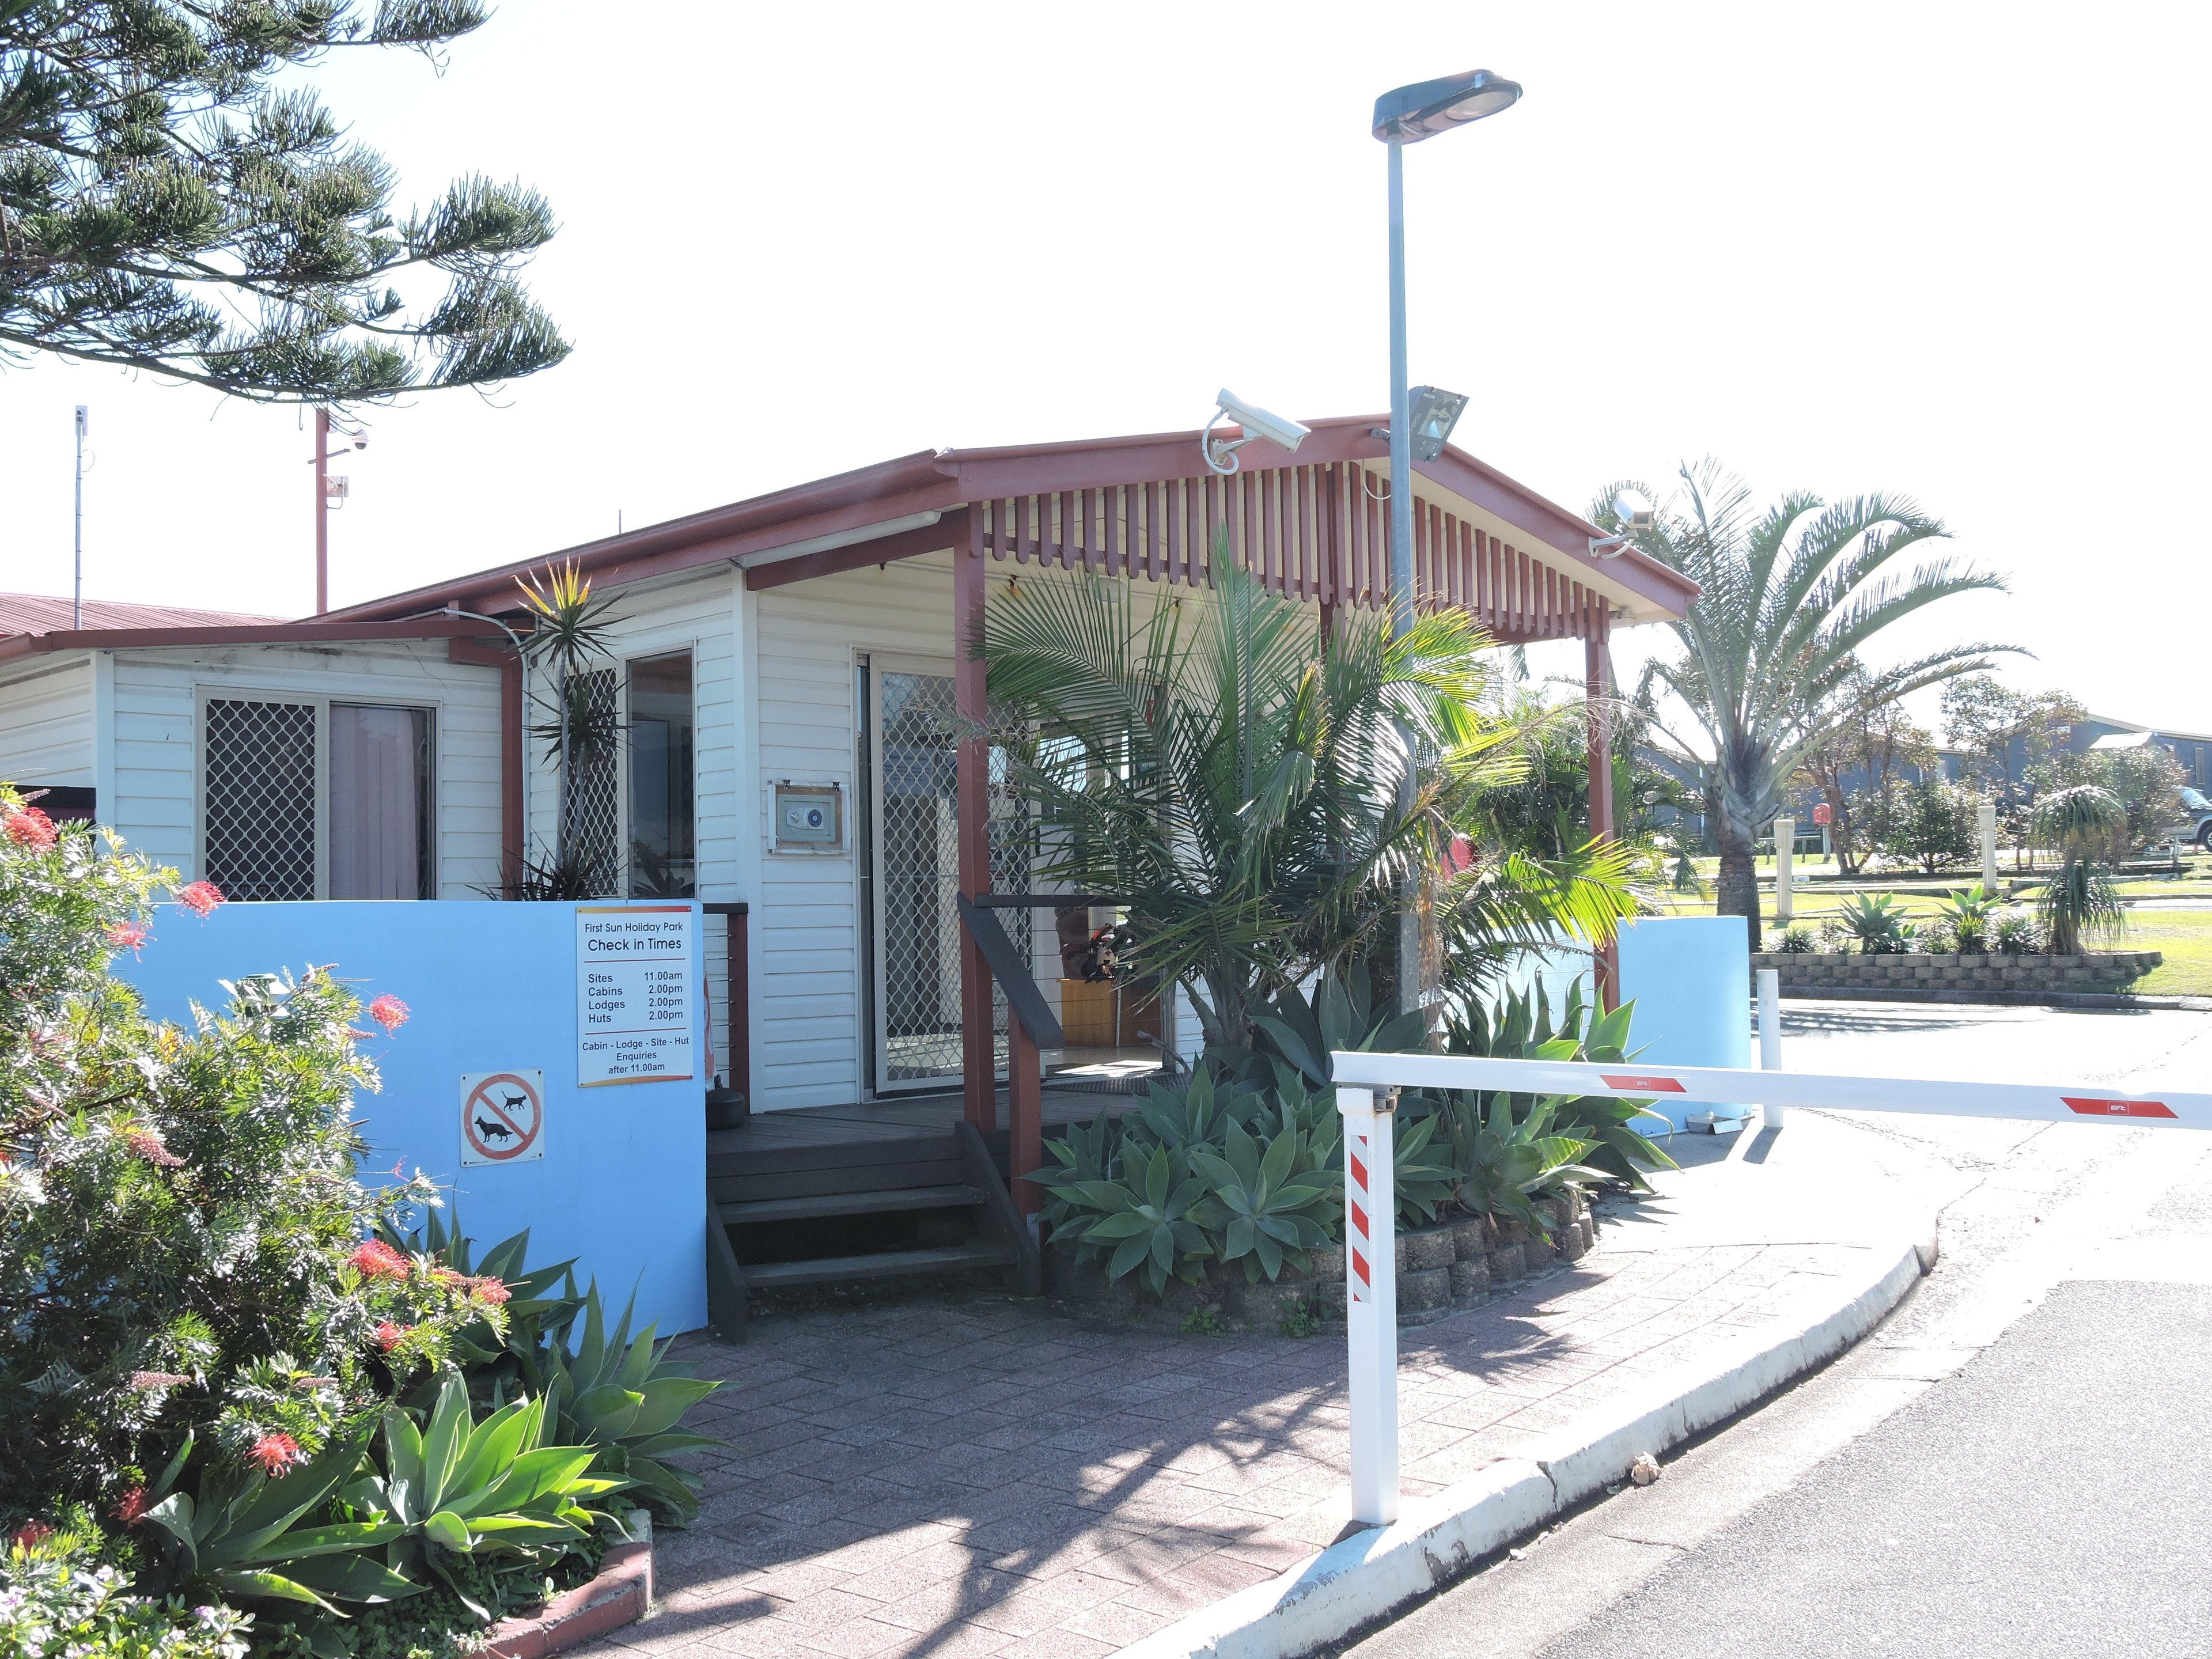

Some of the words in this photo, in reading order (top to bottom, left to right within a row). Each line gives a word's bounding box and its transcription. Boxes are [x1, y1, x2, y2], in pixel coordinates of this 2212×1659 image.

[585, 923, 603, 933] First
[605, 923, 622, 932] Sun
[626, 923, 661, 933] Holiday
[664, 922, 683, 931] Park
[588, 939, 630, 951] Check
[634, 938, 644, 950] in
[648, 938, 681, 949] Times
[588, 974, 613, 983] Sites
[644, 971, 683, 981] 11.00am
[588, 987, 623, 997] Cabins
[649, 984, 683, 995] 2.00pm
[589, 1000, 626, 1012] Lodges
[649, 997, 683, 1008] 2.00pm
[589, 1014, 612, 1023] Huts
[649, 1010, 683, 1021] 2.00pm
[582, 1041, 608, 1051] Cabin
[616, 1040, 643, 1050] Lodge
[651, 1038, 667, 1047] Site
[675, 1037, 690, 1046] Hut
[616, 1051, 657, 1062] Enquiries
[608, 1065, 628, 1074] after
[631, 1063, 665, 1073] 11.00am
